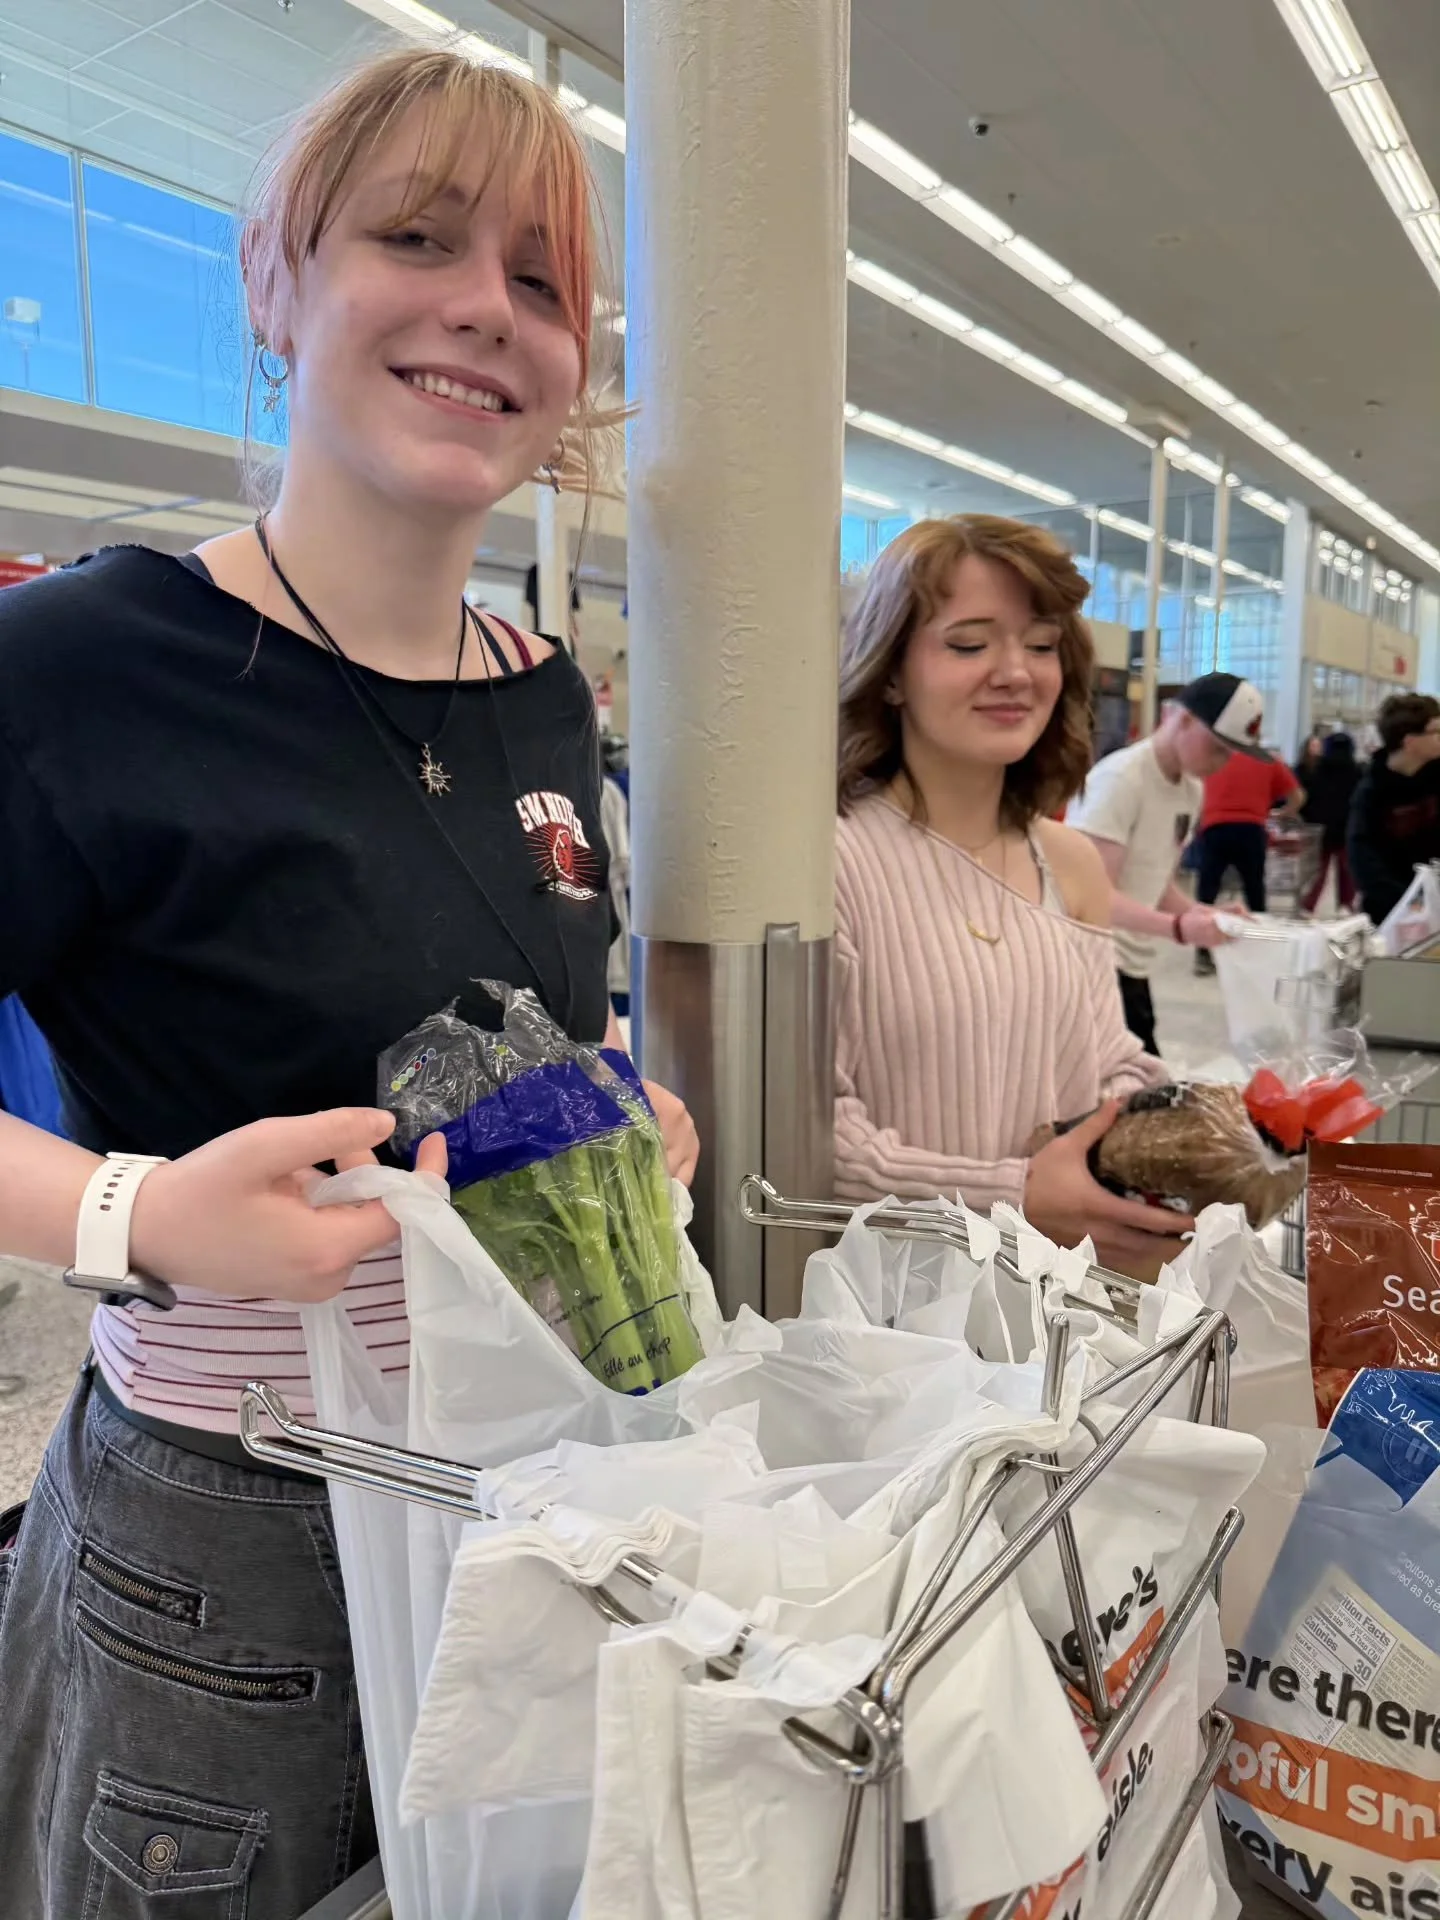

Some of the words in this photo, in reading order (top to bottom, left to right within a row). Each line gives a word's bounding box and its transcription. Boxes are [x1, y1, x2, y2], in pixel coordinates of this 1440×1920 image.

[1423, 1592, 1440, 1614] bre
[1354, 1635, 1369, 1651] Tbsp
[1361, 1615, 1391, 1646] Facts
[1303, 1615, 1340, 1652] Calories
[1352, 1658, 1374, 1682] 30
[1313, 1671, 1440, 1751] ther
